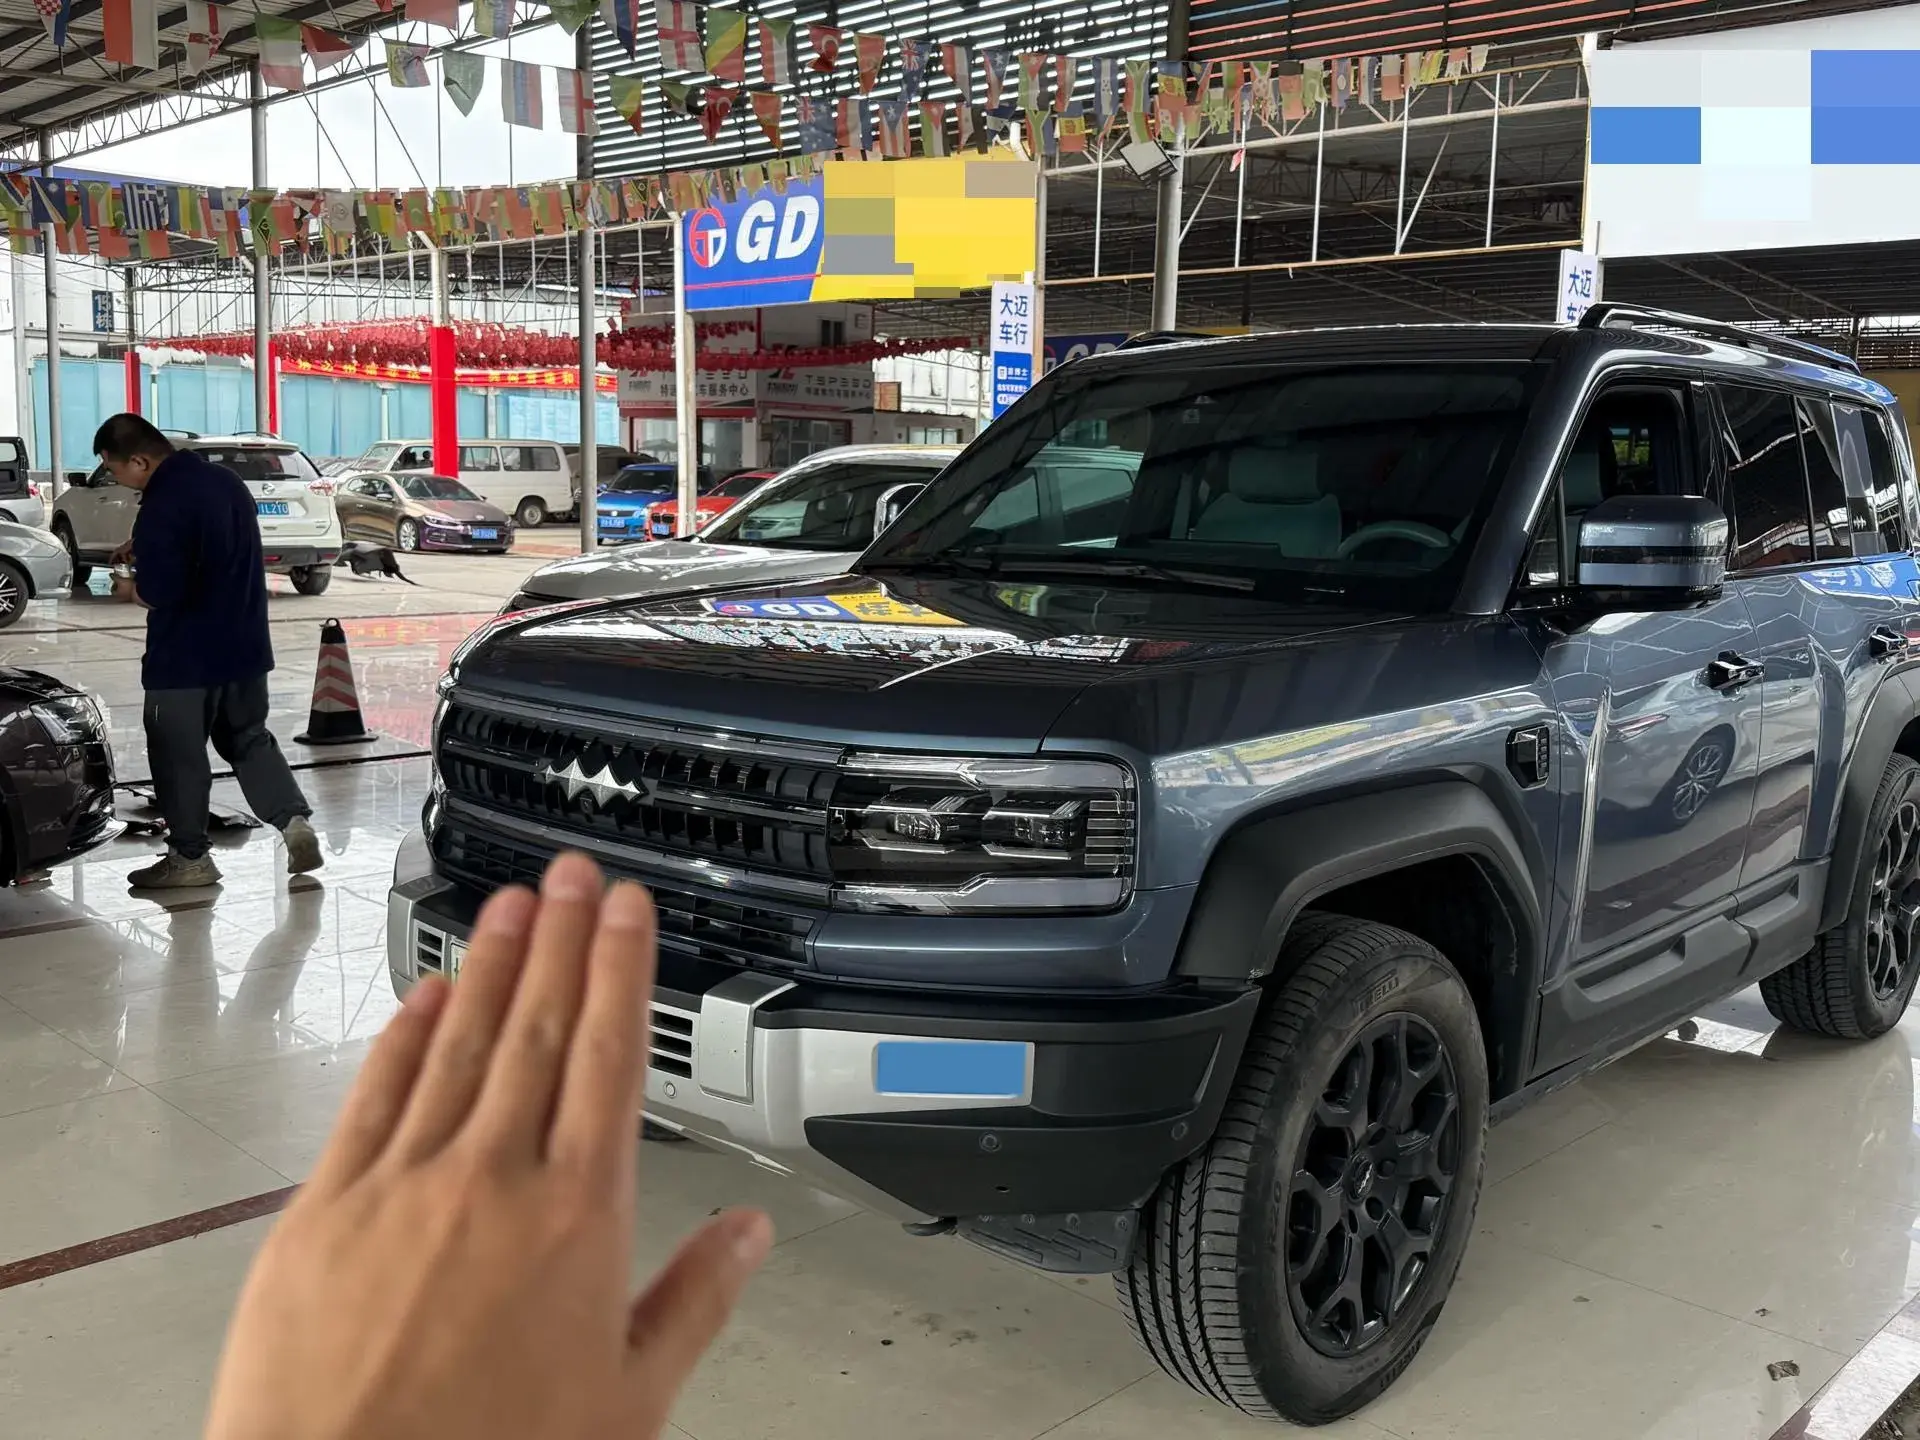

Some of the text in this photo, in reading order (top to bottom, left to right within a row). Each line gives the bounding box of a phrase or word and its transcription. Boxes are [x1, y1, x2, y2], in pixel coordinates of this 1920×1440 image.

[735, 195, 819, 263] GD
[1568, 266, 1592, 298] 大迈
[1000, 292, 1028, 317] 大迈
[1000, 320, 1028, 345] 车行
